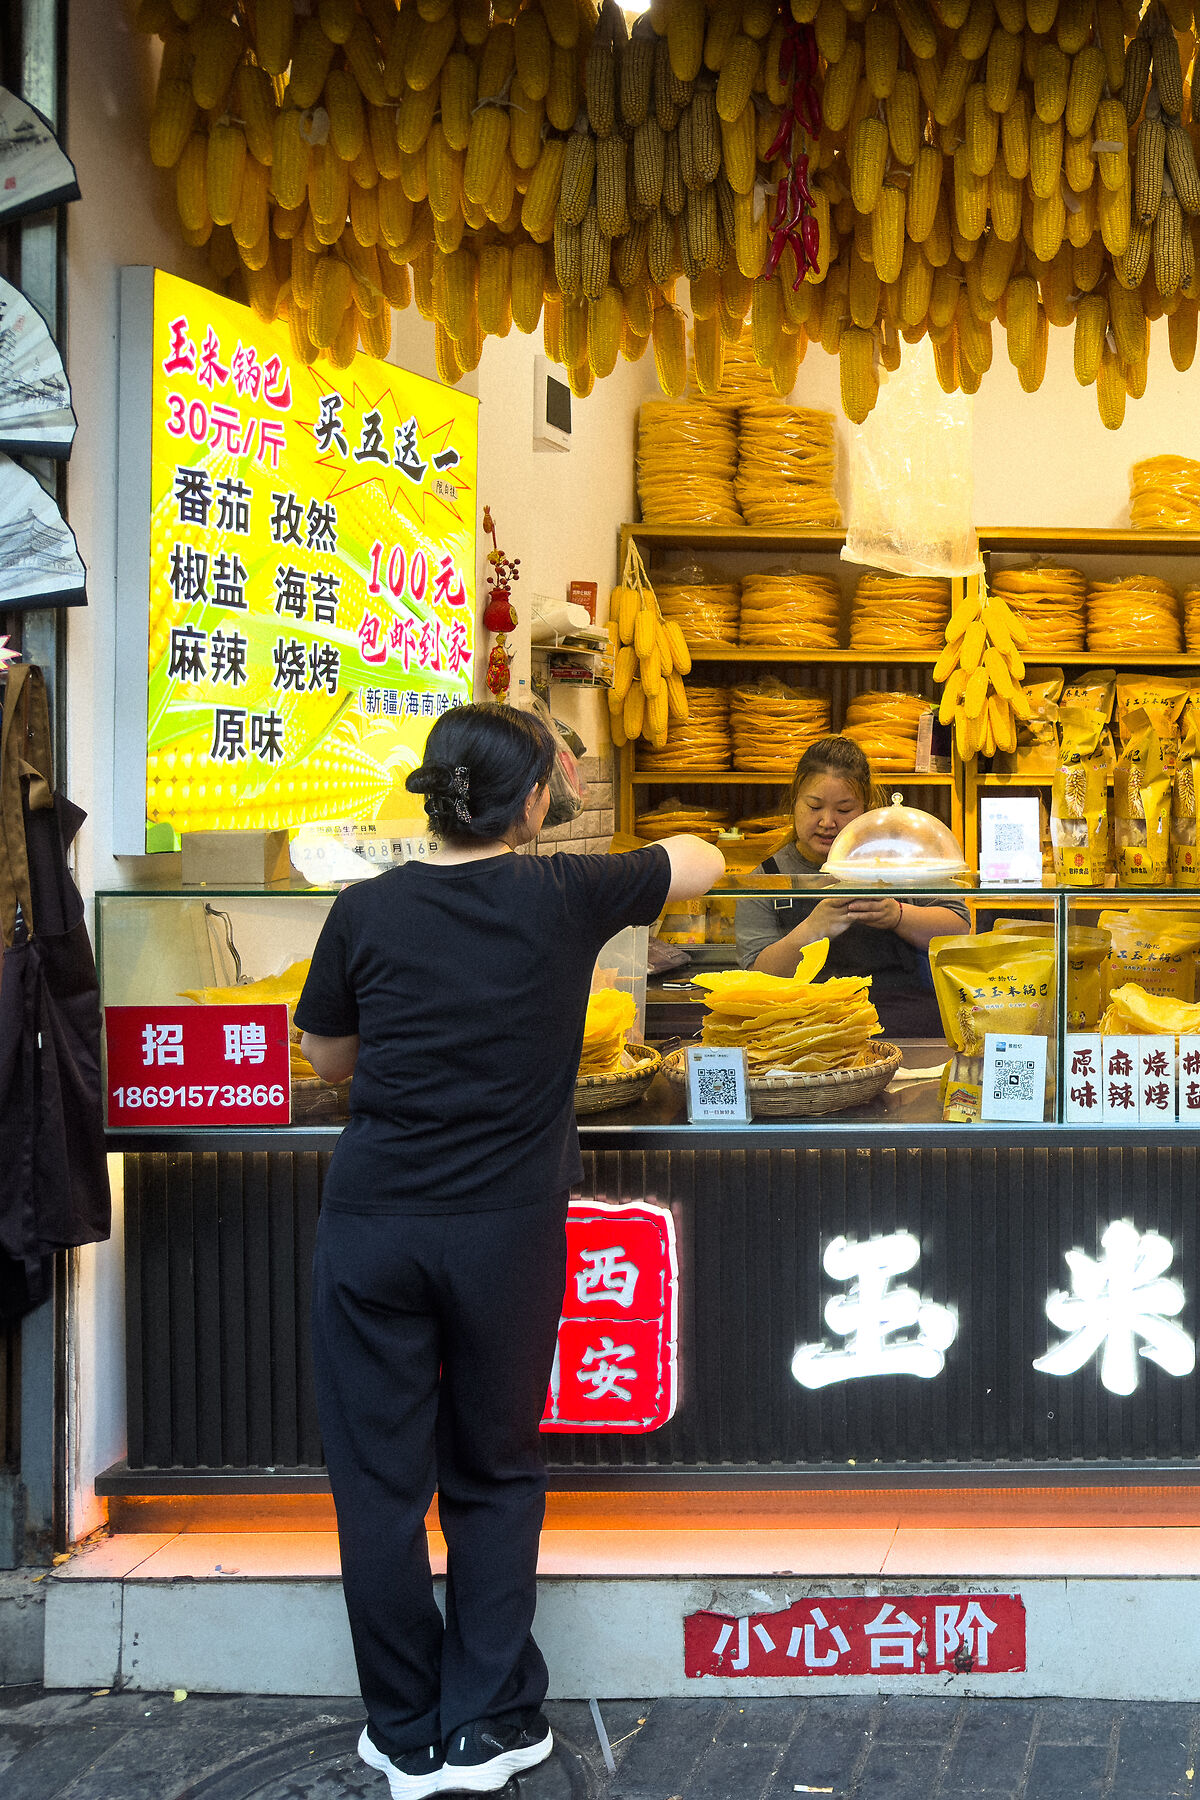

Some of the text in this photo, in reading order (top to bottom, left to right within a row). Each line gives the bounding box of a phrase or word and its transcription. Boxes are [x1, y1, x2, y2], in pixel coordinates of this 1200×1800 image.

[164, 316, 292, 409] 玉米锅巴
[167, 395, 287, 468] 30元/斤
[315, 394, 461, 482] 买五送一
[174, 466, 338, 553] 番茄 孜然
[169, 544, 341, 624] 椒盐 海苔
[368, 542, 467, 607] 100元
[168, 625, 340, 694] 麻辣 烧烤
[358, 612, 473, 673] 包邮到家
[210, 707, 284, 763] 原味
[309, 824, 377, 833] 商品生产日期
[958, 983, 1049, 1004] 手工玉米锅巴
[142, 1022, 267, 1066] 招聘
[112, 1084, 285, 1108] 18691573866
[1070, 1048, 1098, 1109] 原味
[1107, 1049, 1136, 1110] 麻辣
[1142, 1049, 1171, 1110] 烧烤
[574, 1244, 641, 1405] 西安
[712, 1601, 998, 1670] 小心台阶
